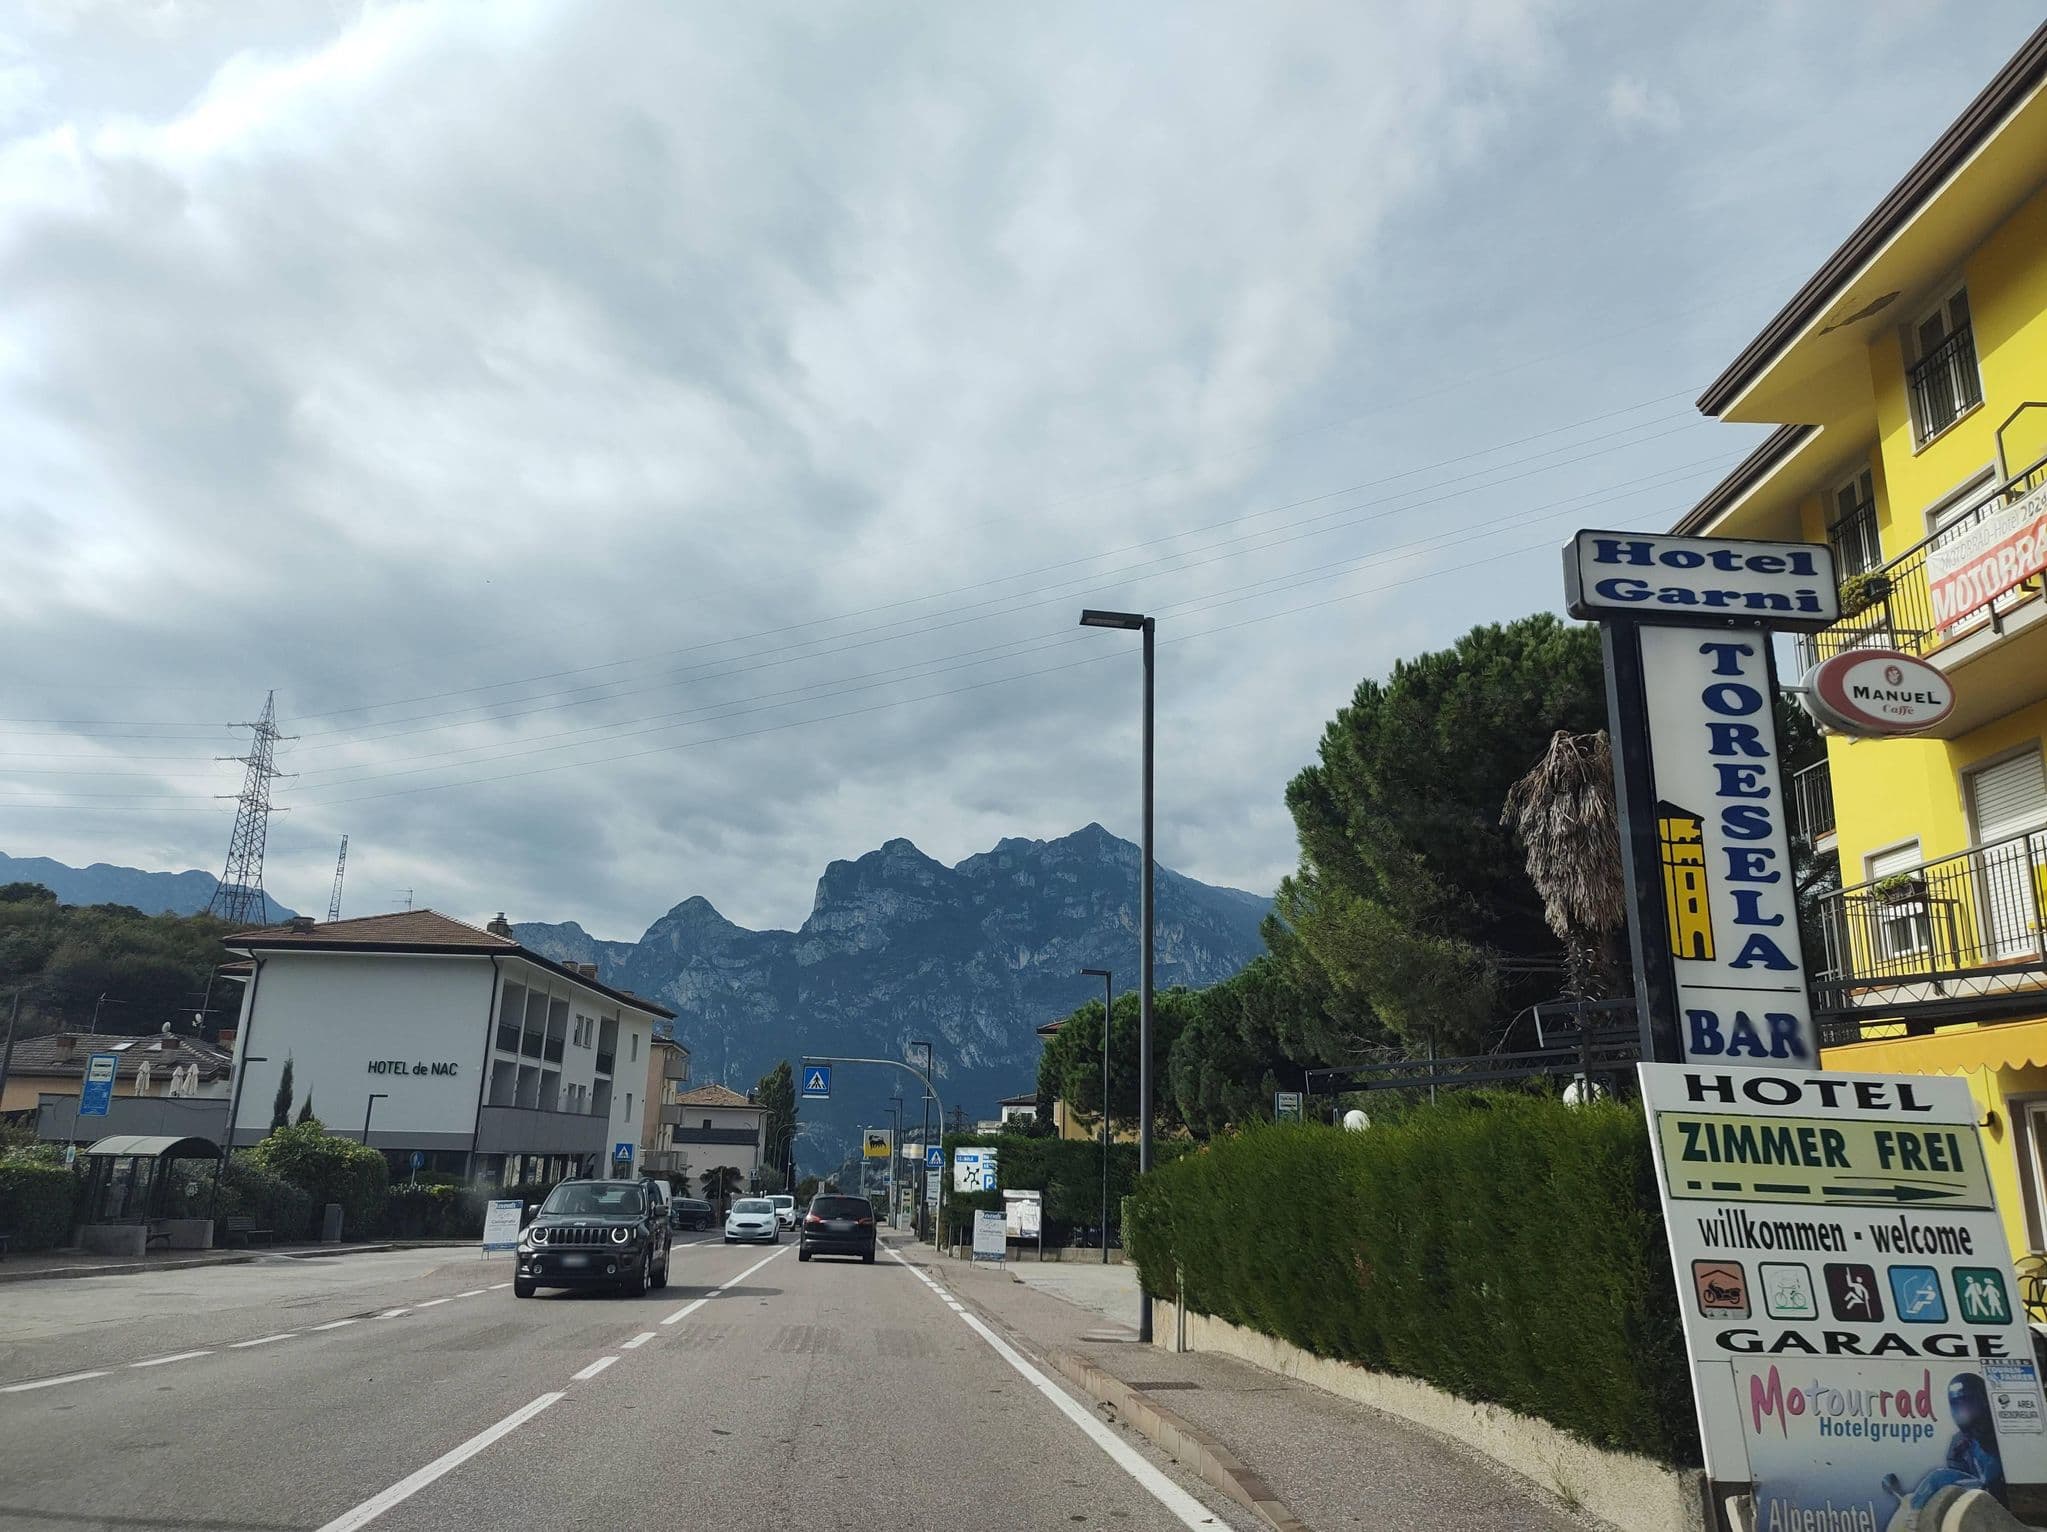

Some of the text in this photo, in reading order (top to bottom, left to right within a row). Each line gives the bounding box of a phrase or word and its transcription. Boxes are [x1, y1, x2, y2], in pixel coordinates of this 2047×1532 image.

[1592, 539, 1819, 576] Hotel
[1595, 578, 1823, 613] Garni
[1853, 685, 1942, 705] MANUEL
[1699, 642, 1799, 972] TORESELA
[1685, 1009, 1808, 1059] BAR
[368, 1060, 459, 1076] HOTEL de NAC
[1684, 1074, 1934, 1112] HOTEL
[1677, 1121, 1965, 1173] ZIMMER FREI
[1697, 1208, 1848, 1252] willkommen
[1868, 1214, 1974, 1256] welcome
[1715, 1328, 2010, 1358] GARAGE
[1750, 1364, 1938, 1440] Motourrad
[2017, 1400, 2035, 1408] AREA
[1820, 1417, 1934, 1443] Hotelgruppe
[1769, 1498, 1877, 1532] Alpenhotel
